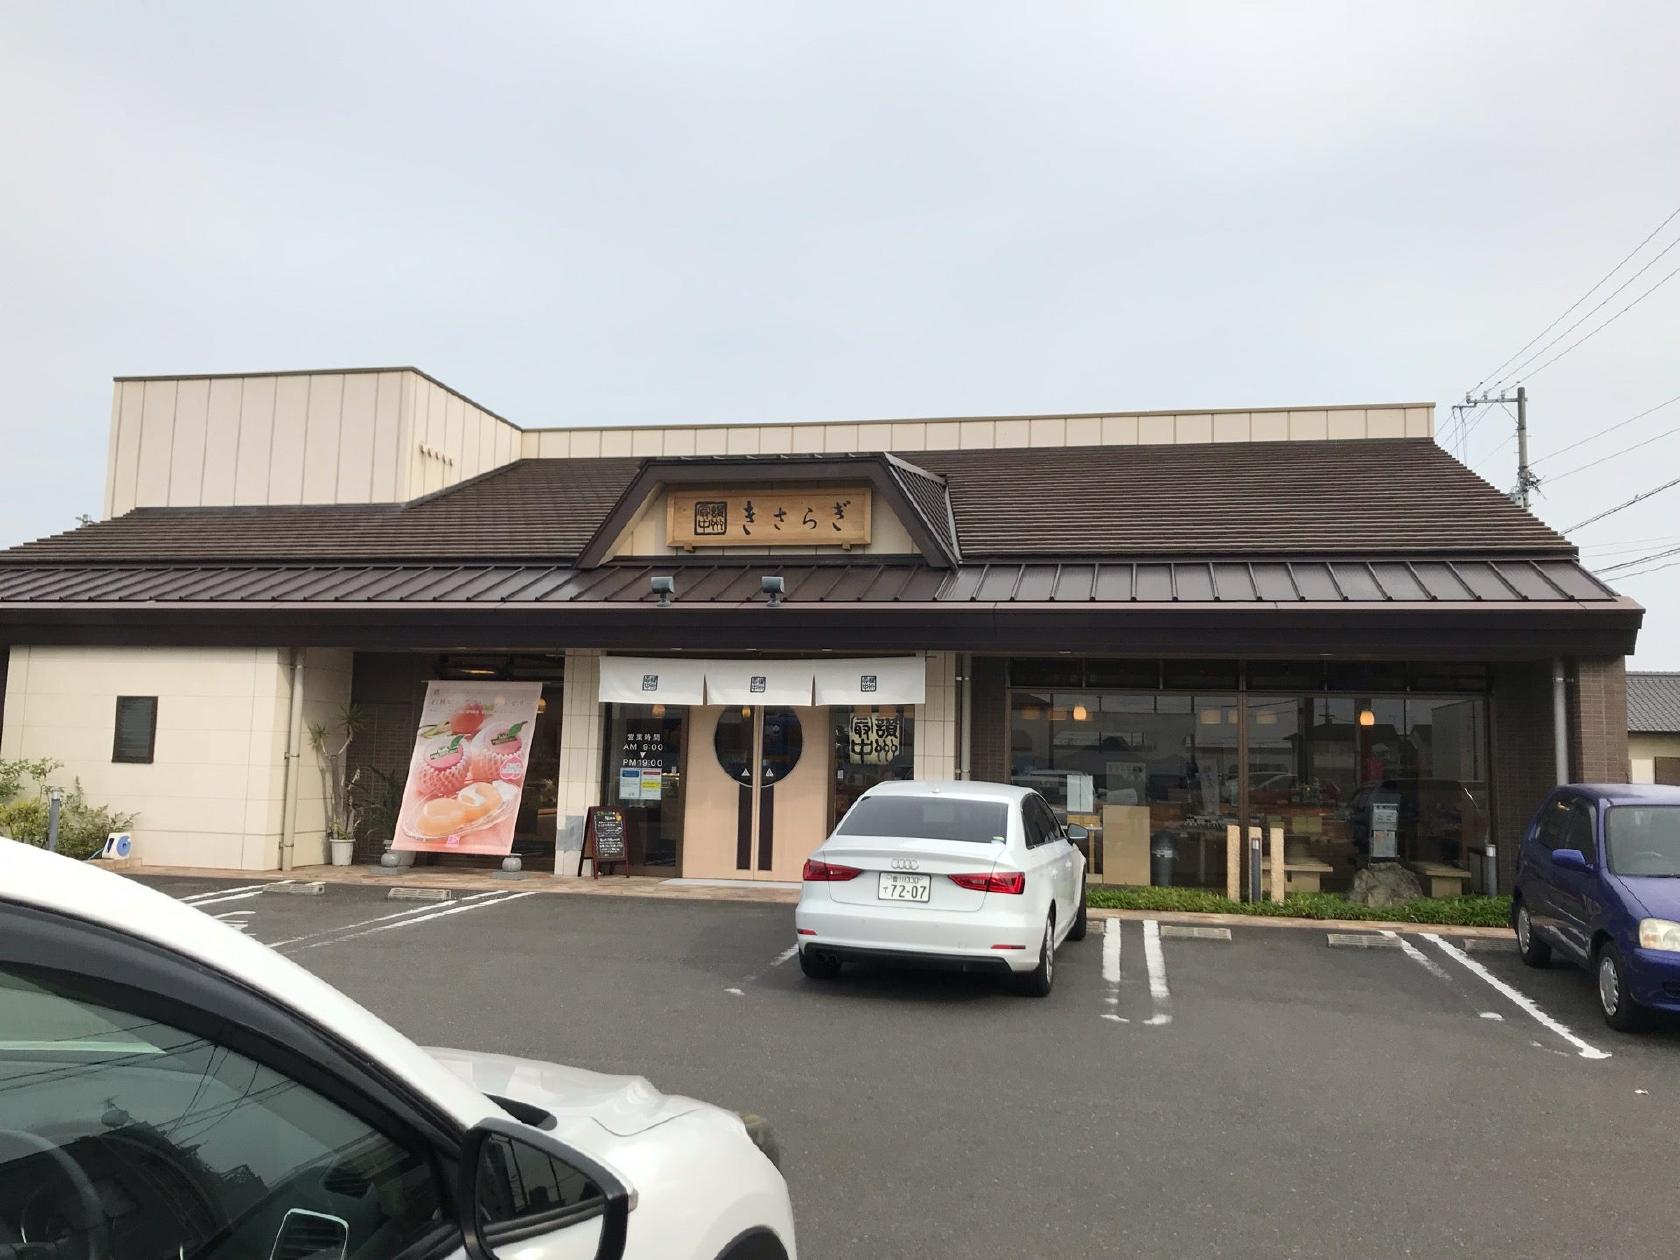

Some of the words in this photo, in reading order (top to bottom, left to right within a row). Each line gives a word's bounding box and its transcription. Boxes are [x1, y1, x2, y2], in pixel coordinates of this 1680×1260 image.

[742, 500, 851, 535] きさらぎ
[623, 743, 637, 751] AM
